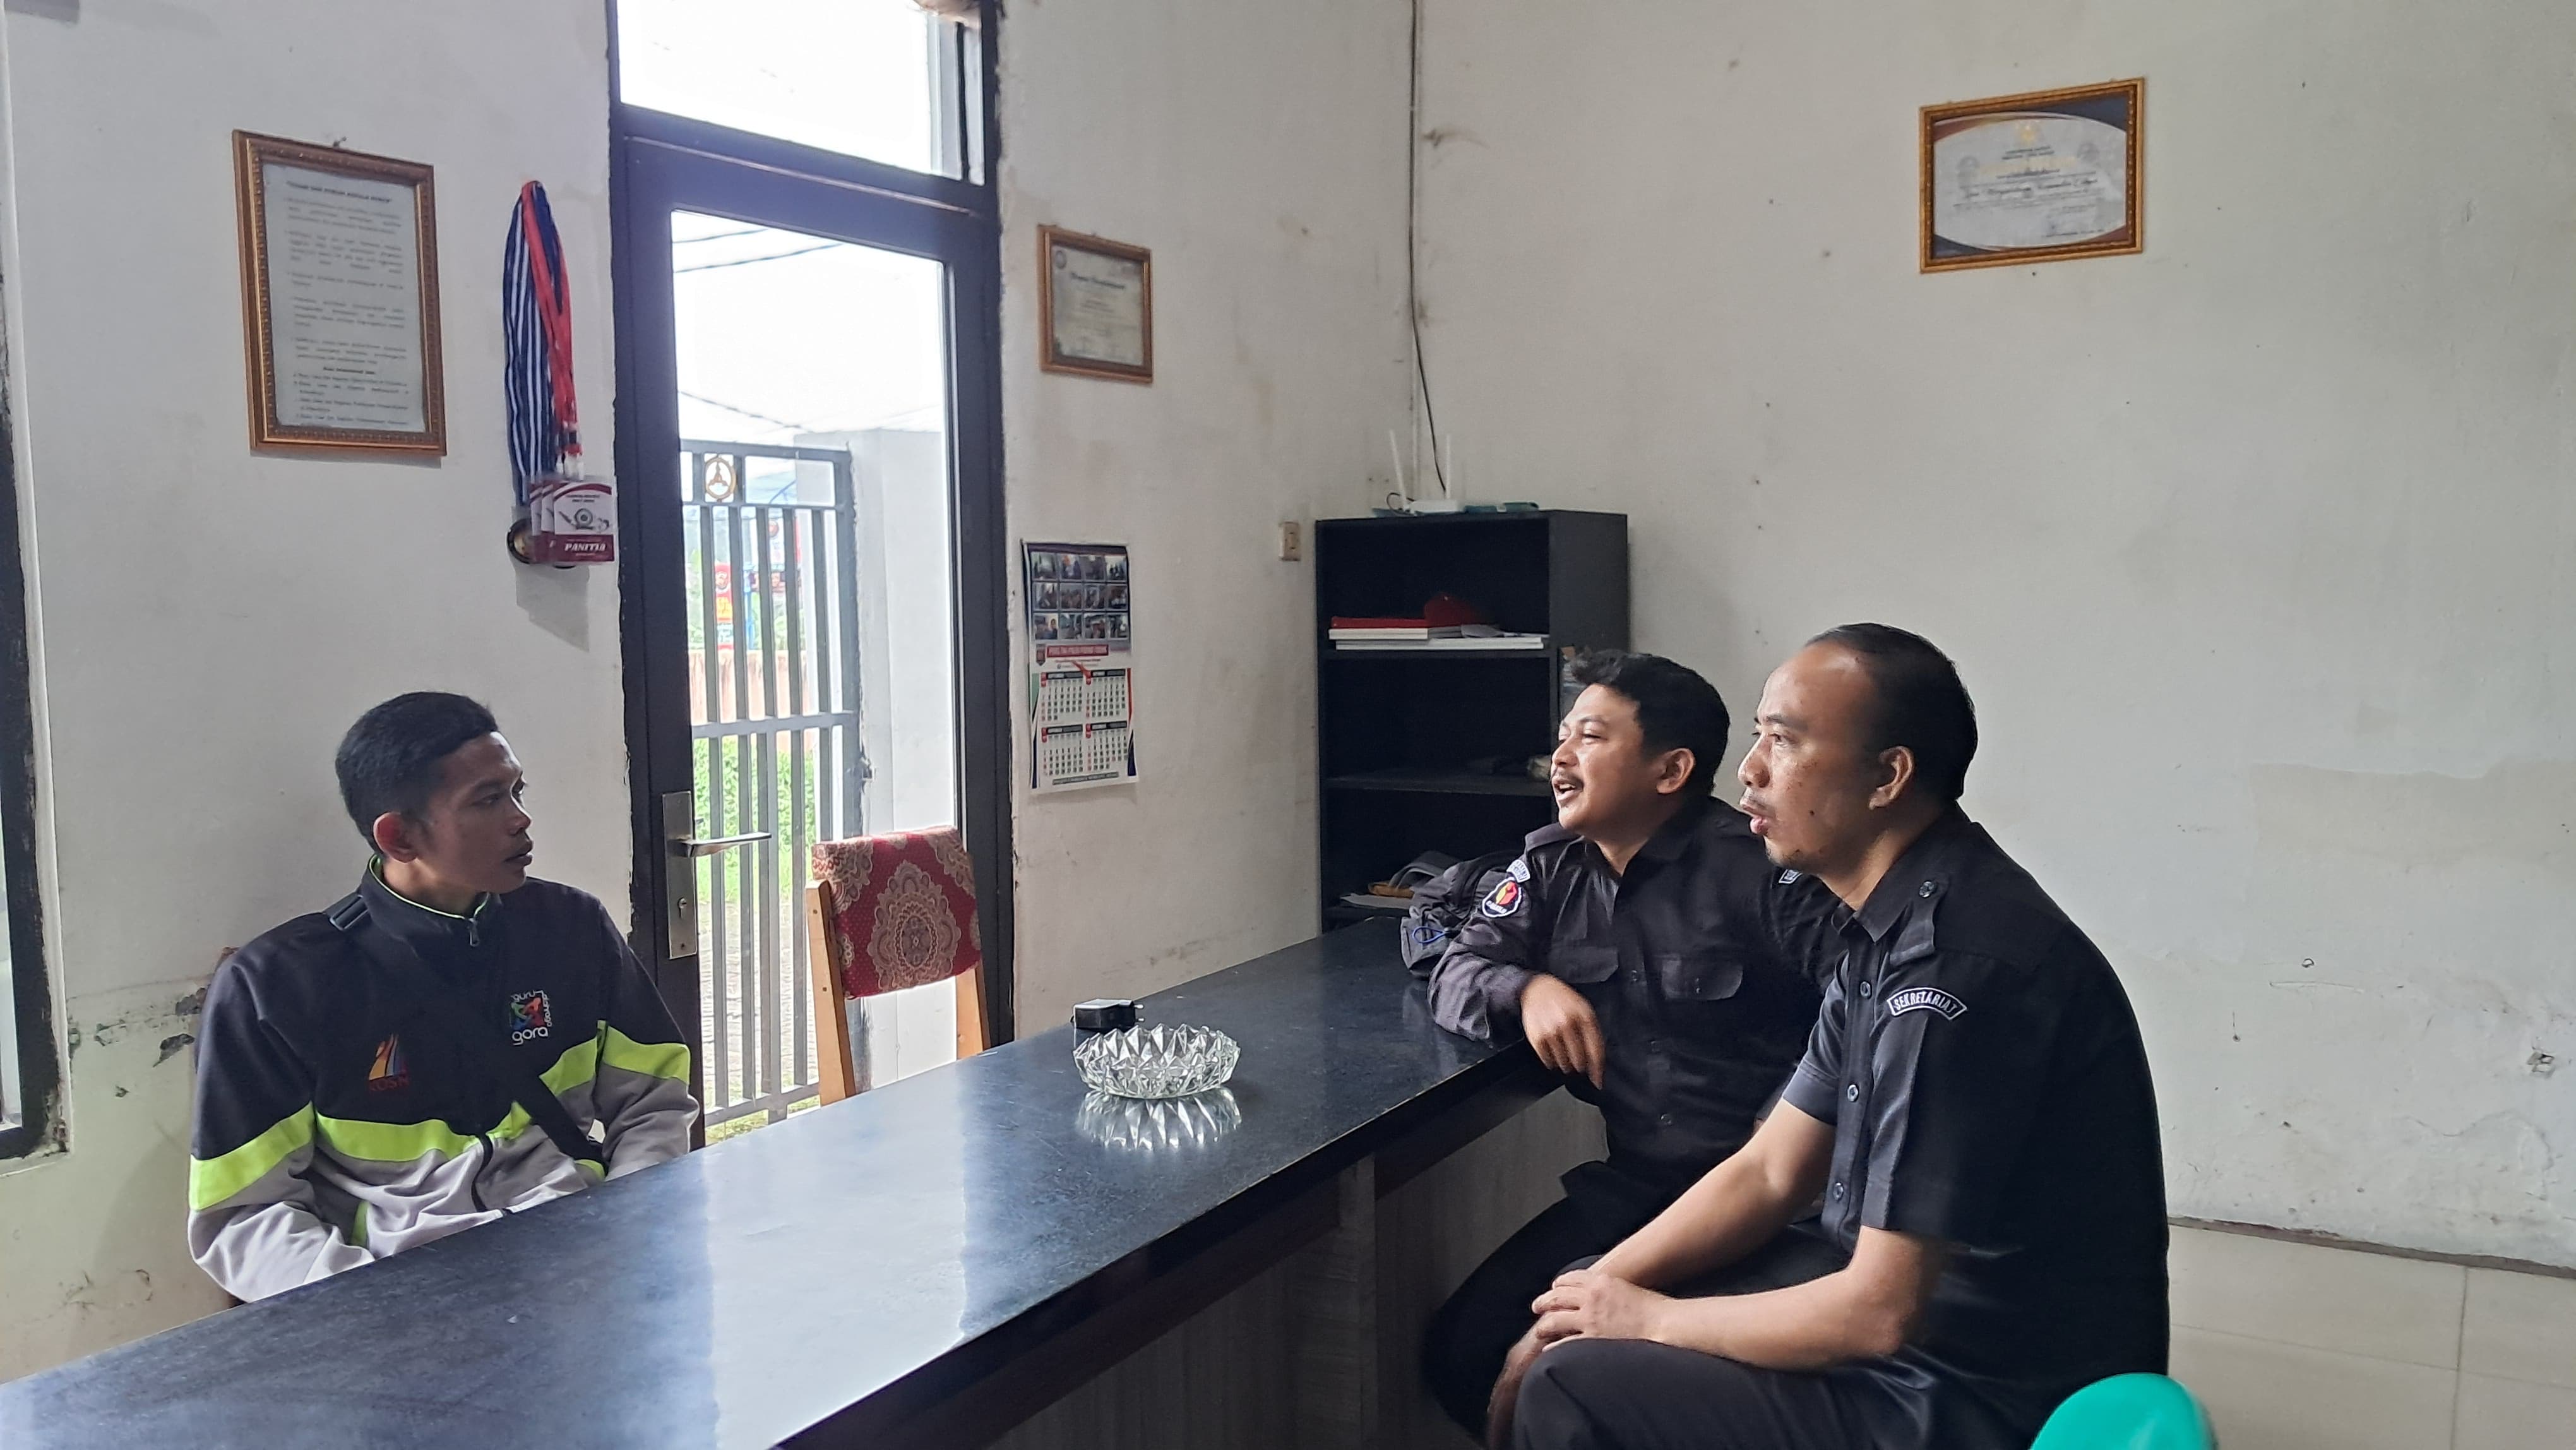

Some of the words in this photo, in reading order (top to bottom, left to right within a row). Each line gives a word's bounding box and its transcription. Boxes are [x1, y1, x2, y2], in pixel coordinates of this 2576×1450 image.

[564, 542, 606, 551] PANITIA
[1893, 990, 1958, 1014] SEKRETARIAT
[511, 1027, 549, 1046] gora
